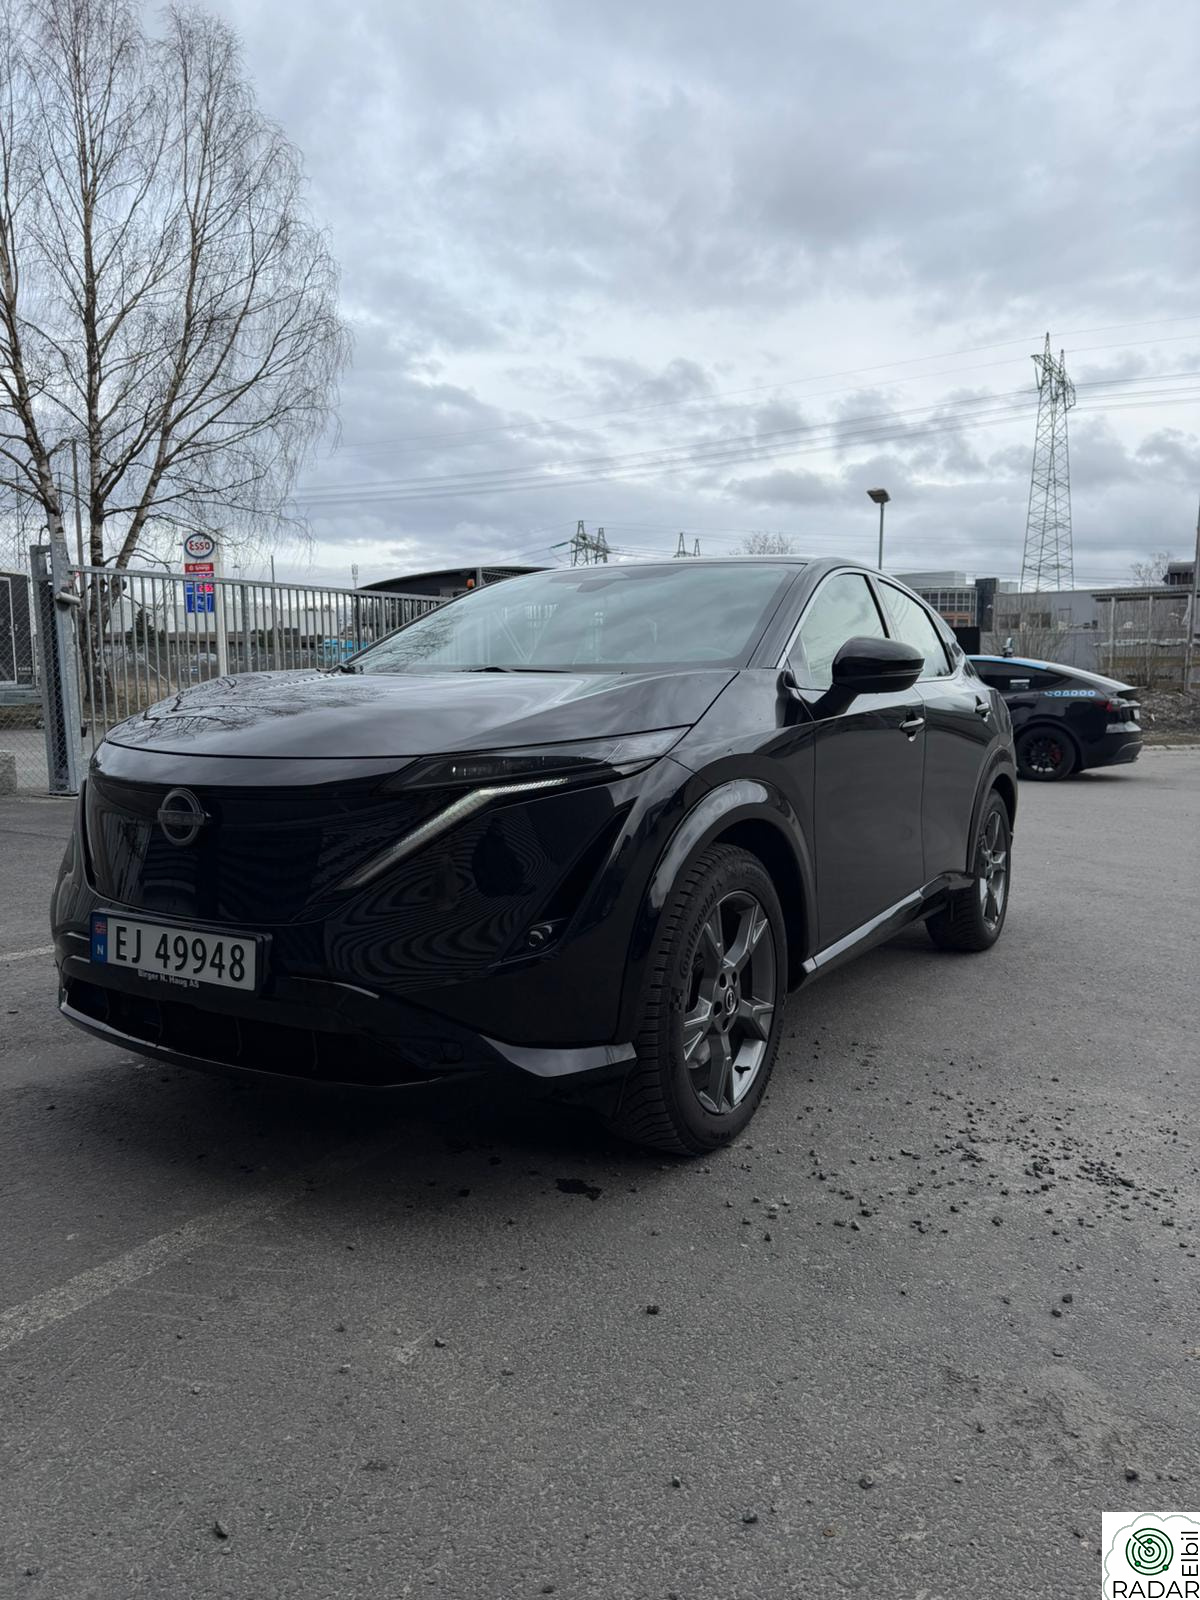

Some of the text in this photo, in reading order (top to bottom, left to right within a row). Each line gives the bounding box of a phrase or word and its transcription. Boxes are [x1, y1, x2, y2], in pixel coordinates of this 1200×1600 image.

[96, 944, 104, 955] N
[115, 926, 245, 982] EJ 49948
[137, 969, 159, 981] Birger
[169, 975, 188, 988] Haug
[189, 979, 200, 989] AS
